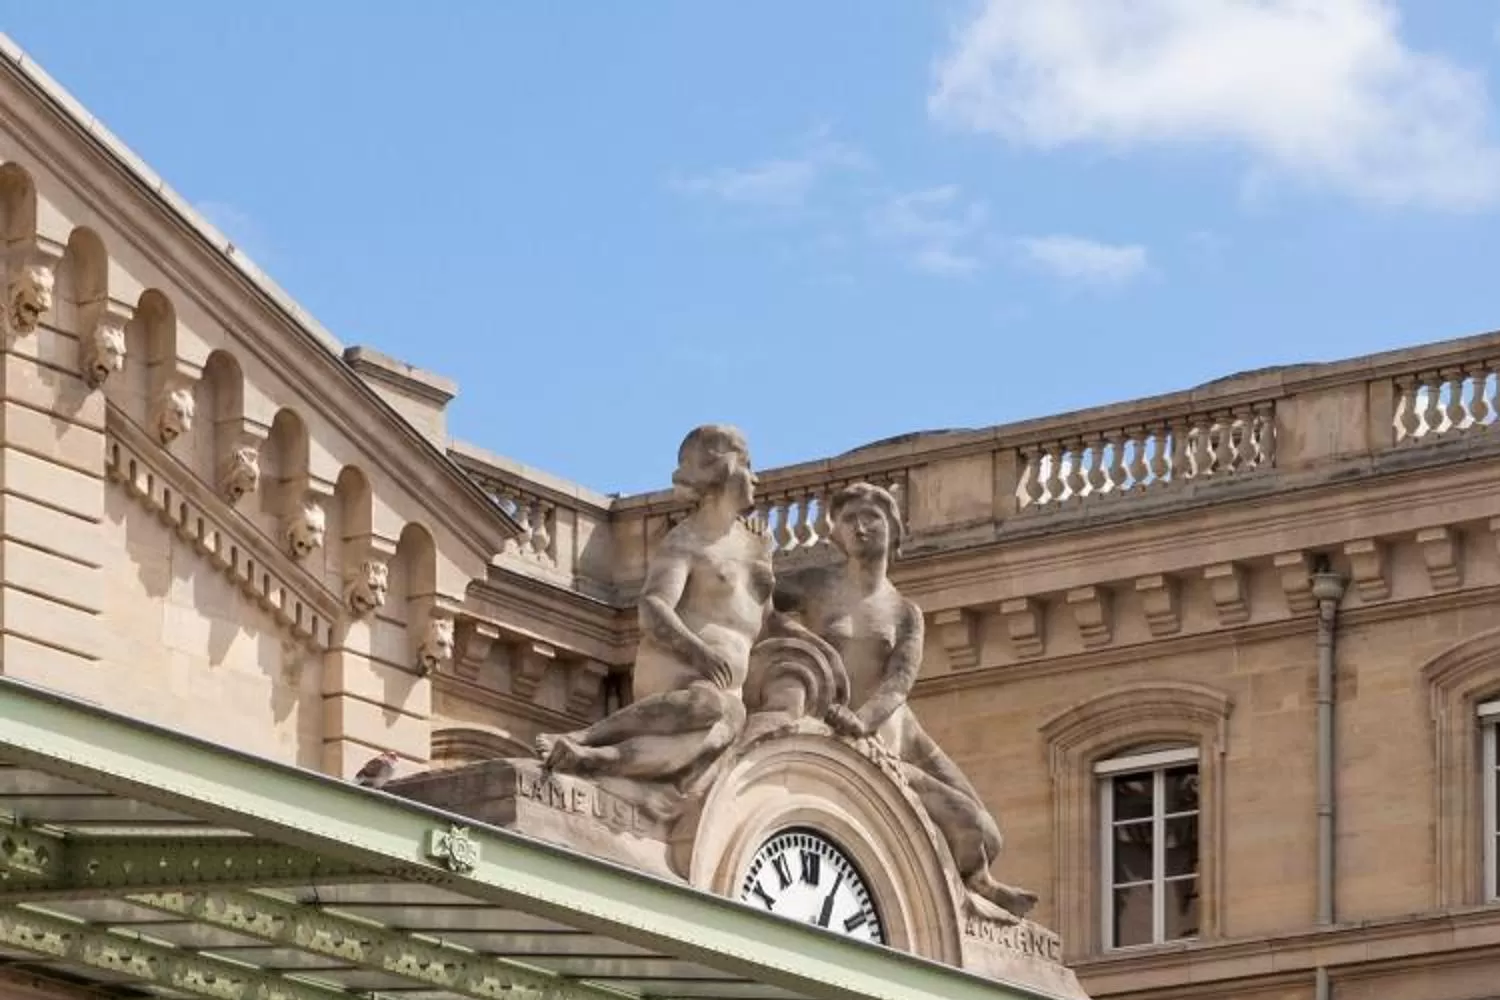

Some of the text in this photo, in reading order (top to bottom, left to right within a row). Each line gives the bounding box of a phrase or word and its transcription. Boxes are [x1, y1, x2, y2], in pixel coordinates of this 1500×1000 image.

[548, 780, 648, 833] MEUSE
[771, 852, 793, 890] XI
[799, 849, 821, 886] XII
[752, 880, 776, 911] X
